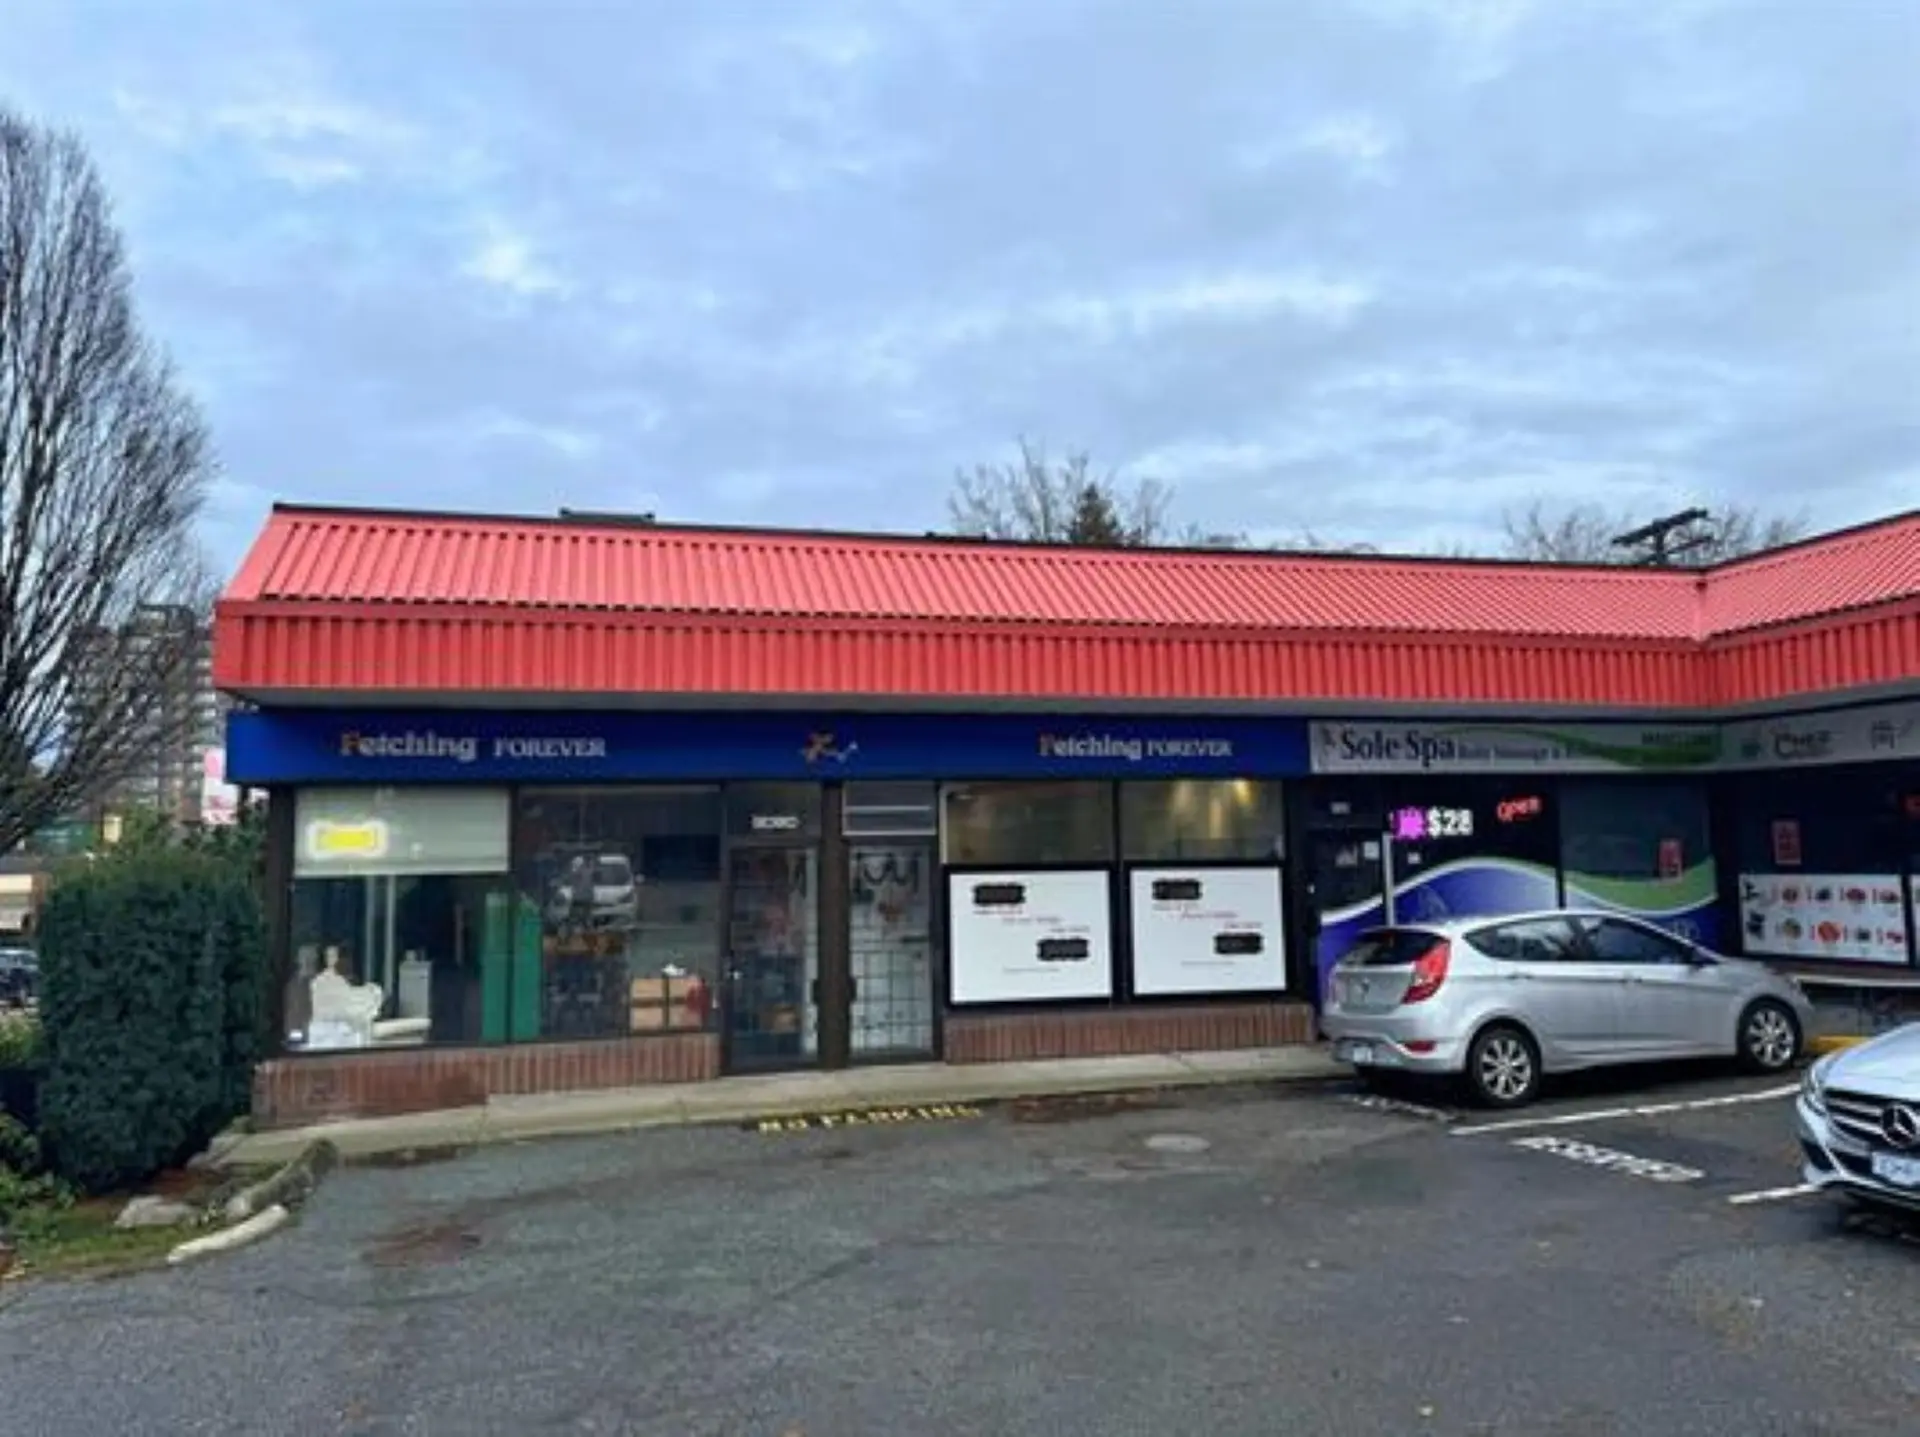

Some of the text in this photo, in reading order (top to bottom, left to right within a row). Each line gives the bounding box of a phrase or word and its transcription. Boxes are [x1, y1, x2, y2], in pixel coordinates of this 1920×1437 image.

[340, 731, 605, 762] Fetching FOREVER
[1039, 734, 1142, 760] Fetching
[1341, 728, 1455, 768] Sole Spa
